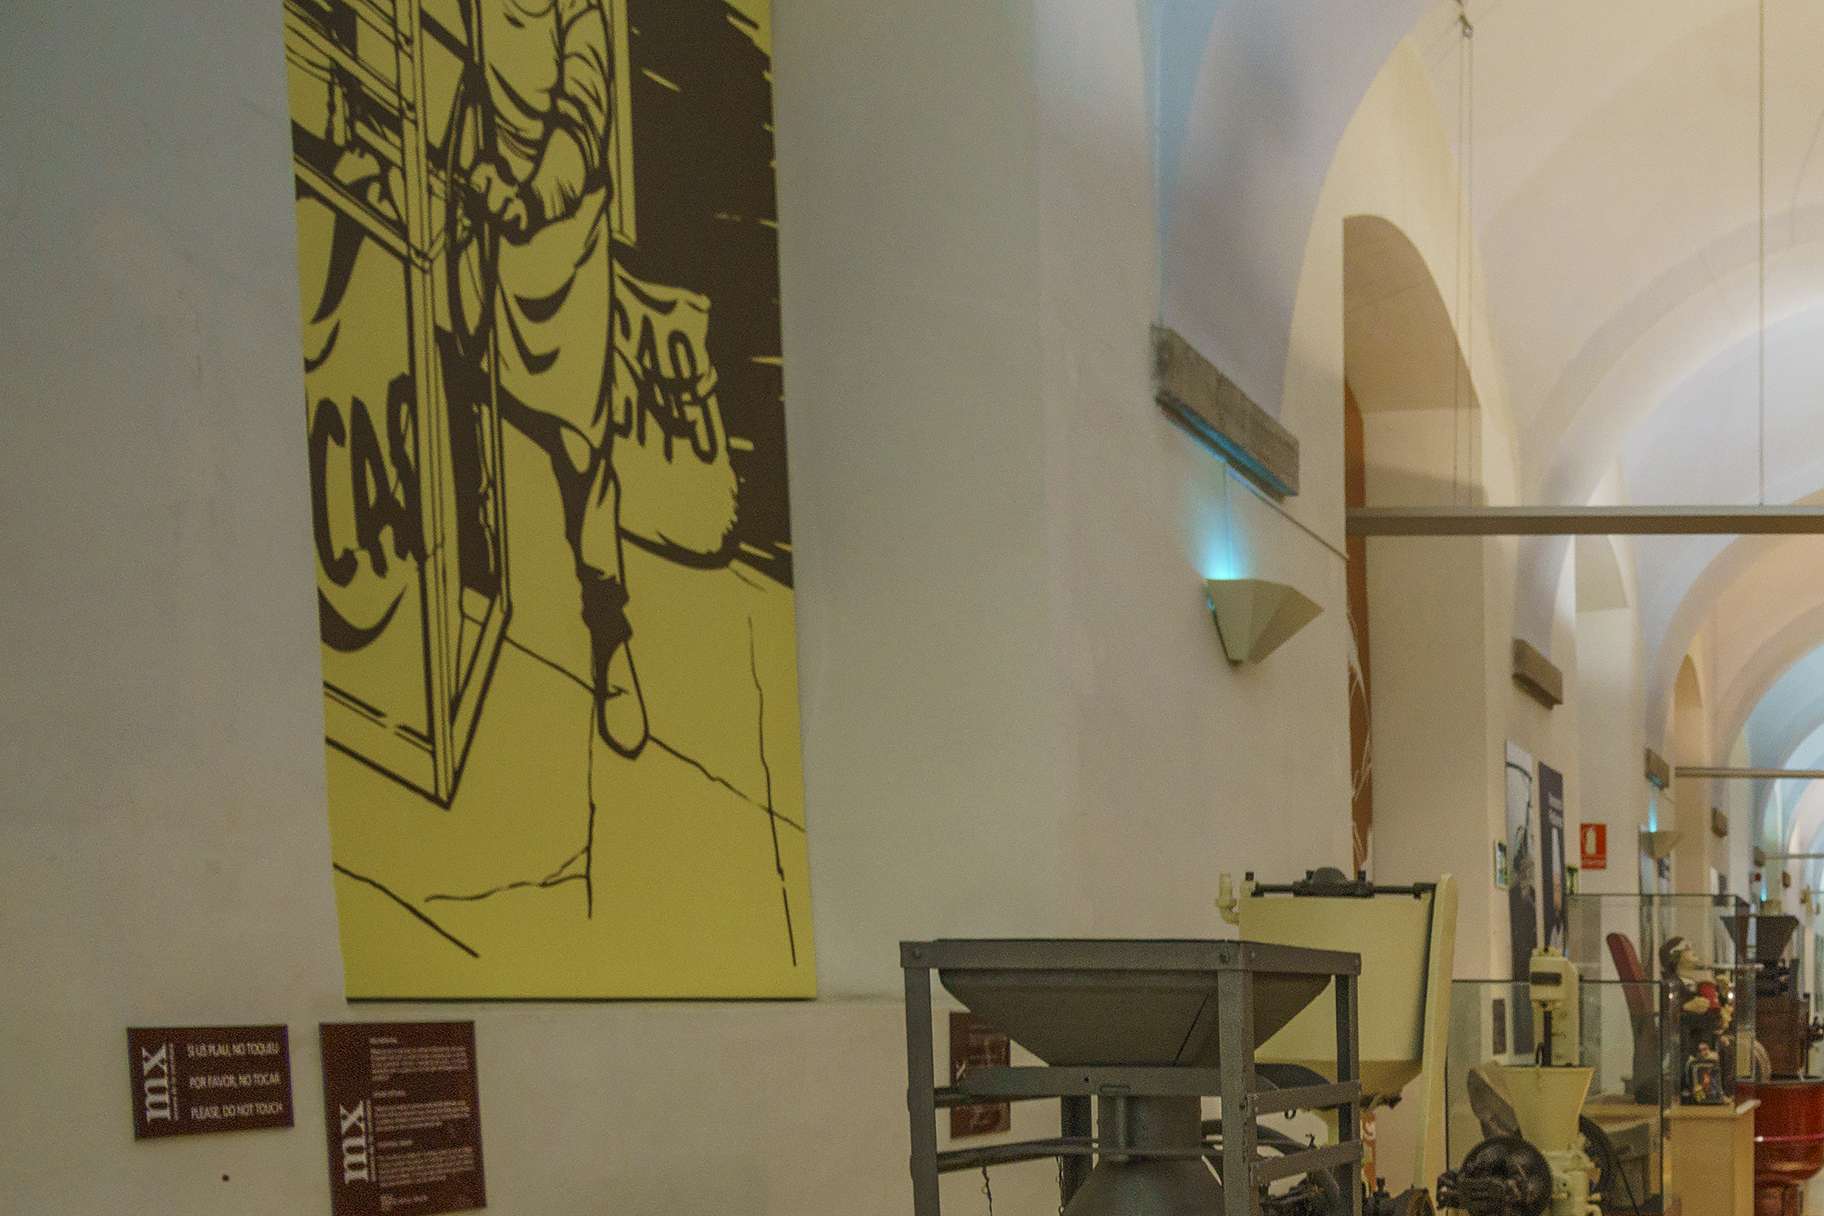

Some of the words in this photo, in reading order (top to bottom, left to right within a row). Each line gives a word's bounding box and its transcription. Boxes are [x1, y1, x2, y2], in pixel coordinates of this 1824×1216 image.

[232, 1042, 247, 1057] NO
[141, 1043, 171, 1125] mx
[189, 1075, 207, 1090] POR
[238, 1073, 252, 1088] NO
[252, 1072, 281, 1086] TOCAR
[222, 1104, 236, 1118] DO
[236, 1102, 254, 1117] NOT
[254, 1101, 283, 1116] TOUCH
[339, 1100, 369, 1185] mx
